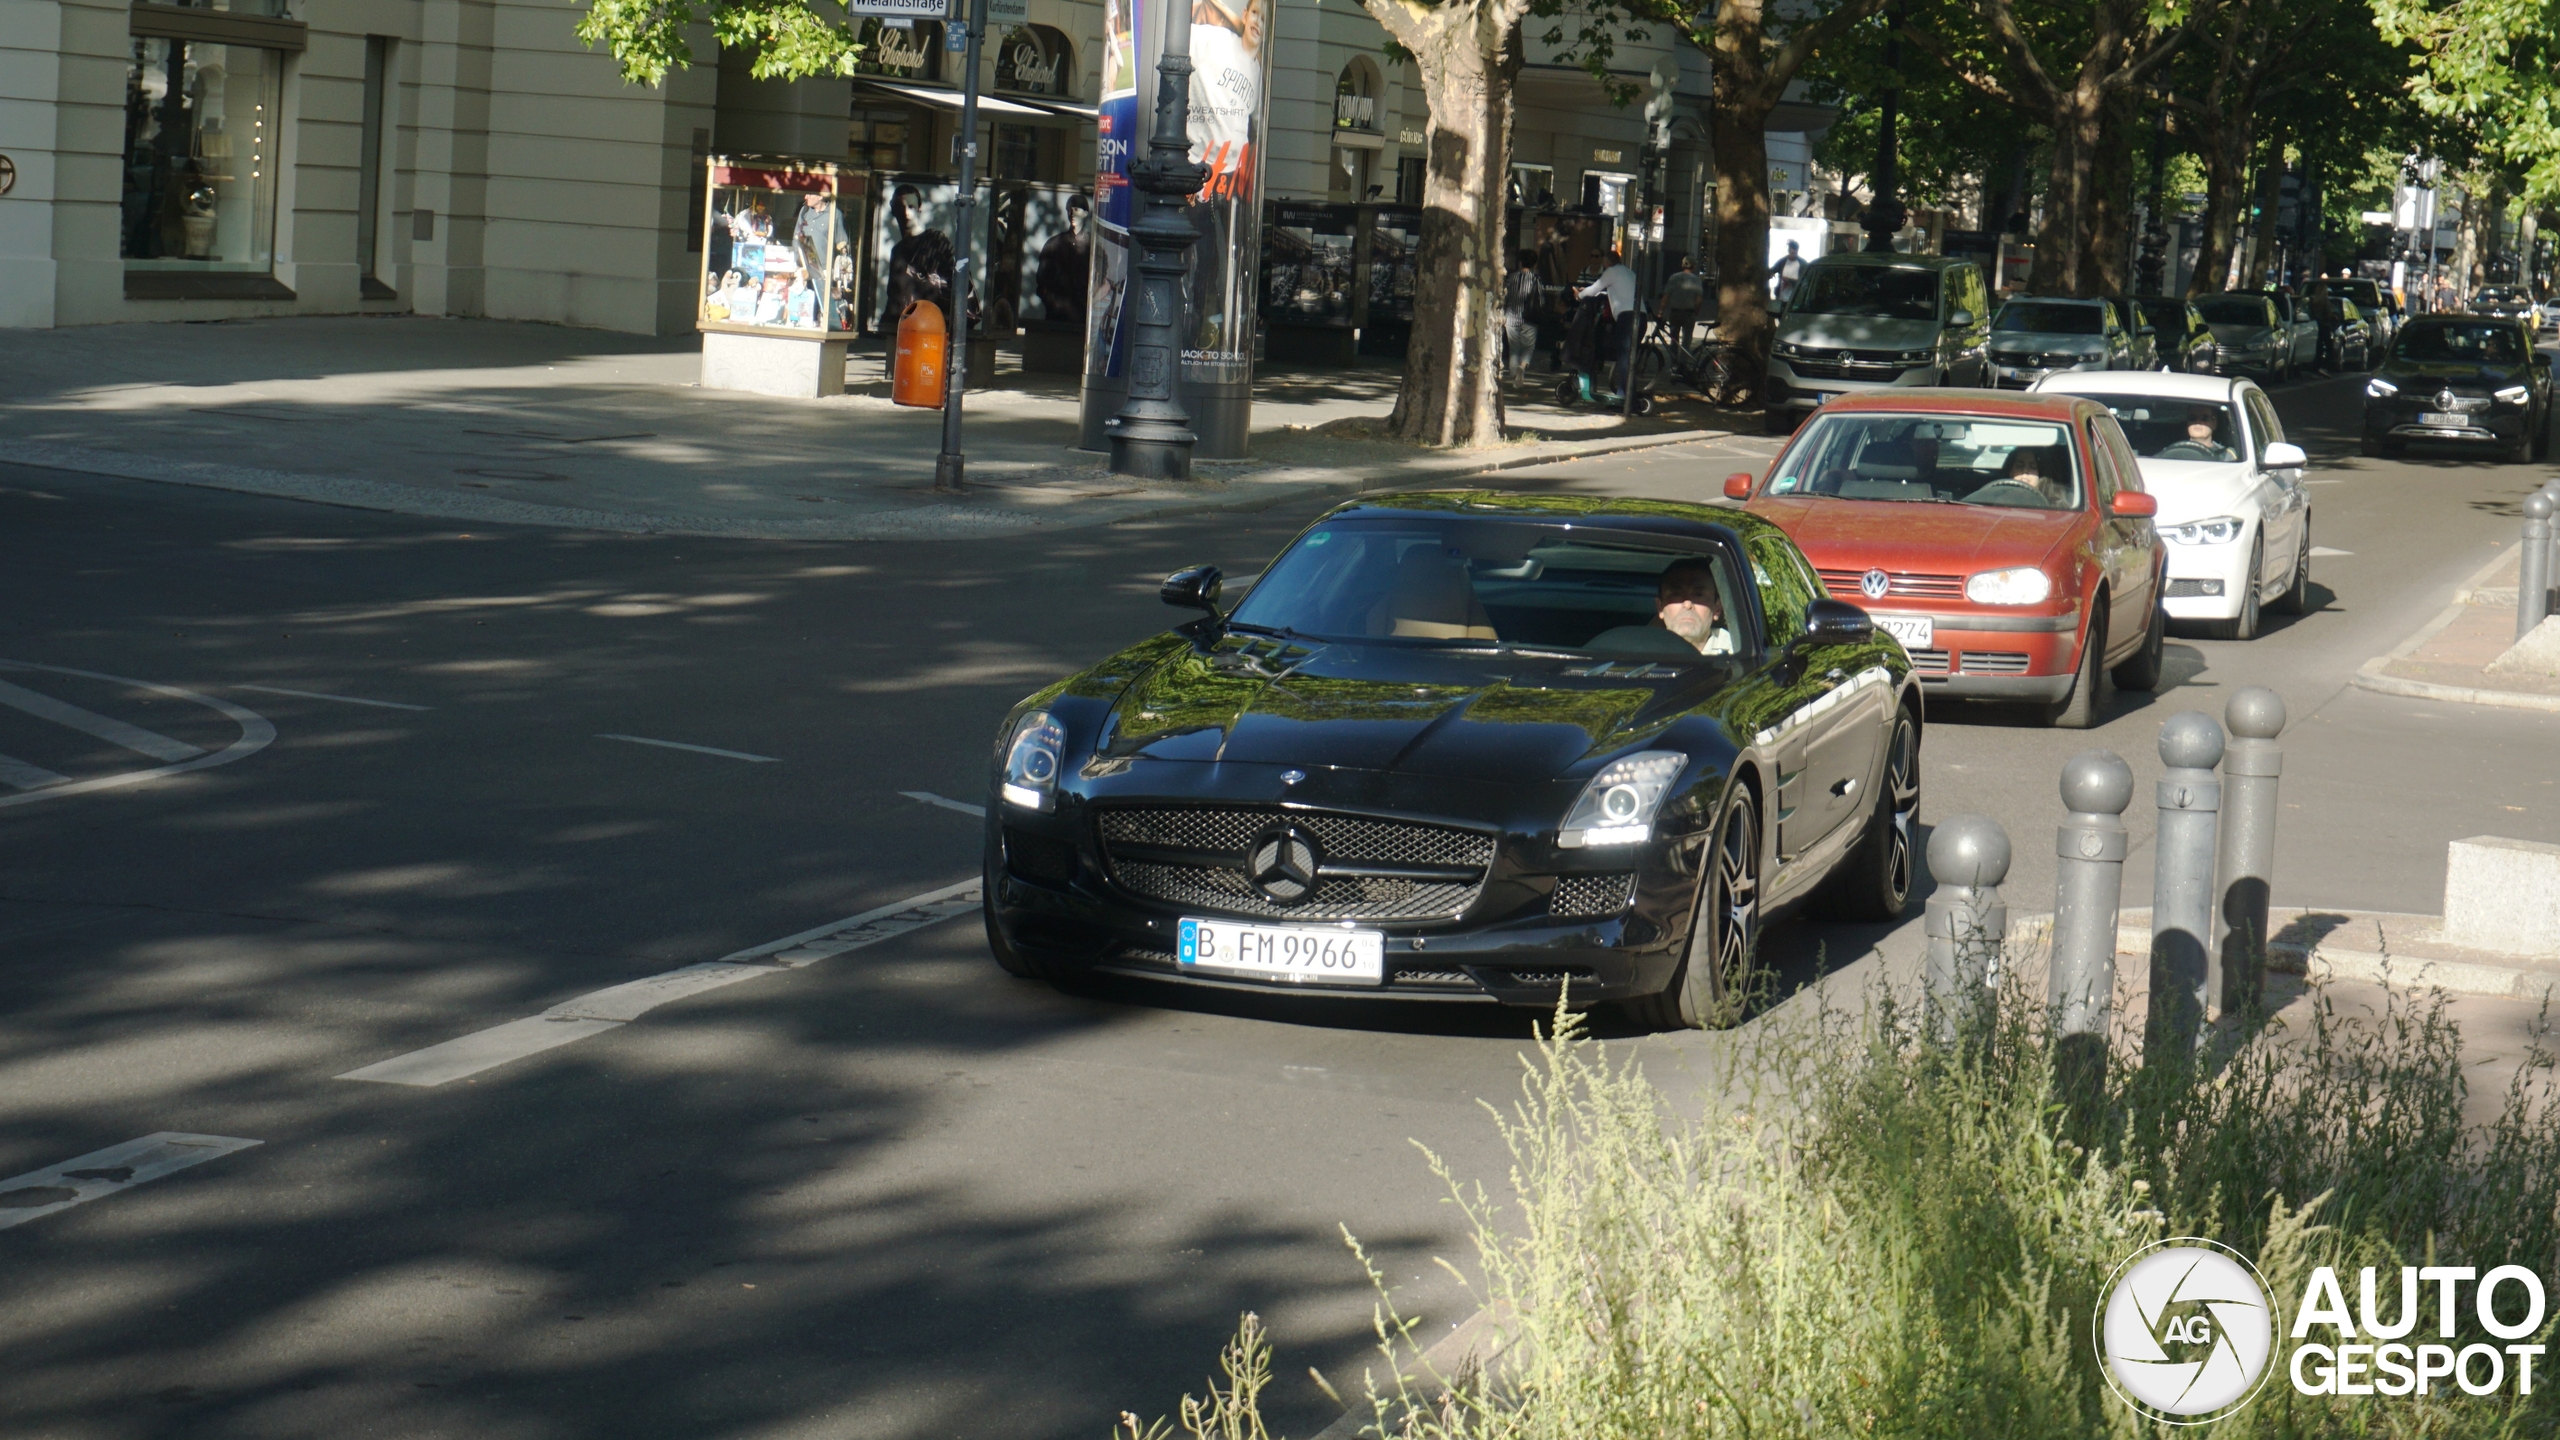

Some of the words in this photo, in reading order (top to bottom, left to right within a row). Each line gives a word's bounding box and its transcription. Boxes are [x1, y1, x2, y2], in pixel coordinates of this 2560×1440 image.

[877, 27, 930, 74] Chopard
[1013, 43, 1059, 90] Chopard
[1338, 94, 1374, 121] RIMOWA
[1206, 351, 1219, 360] TO
[1198, 927, 1215, 958] B
[1239, 931, 1275, 964] FM
[1284, 936, 1356, 969] 9966
